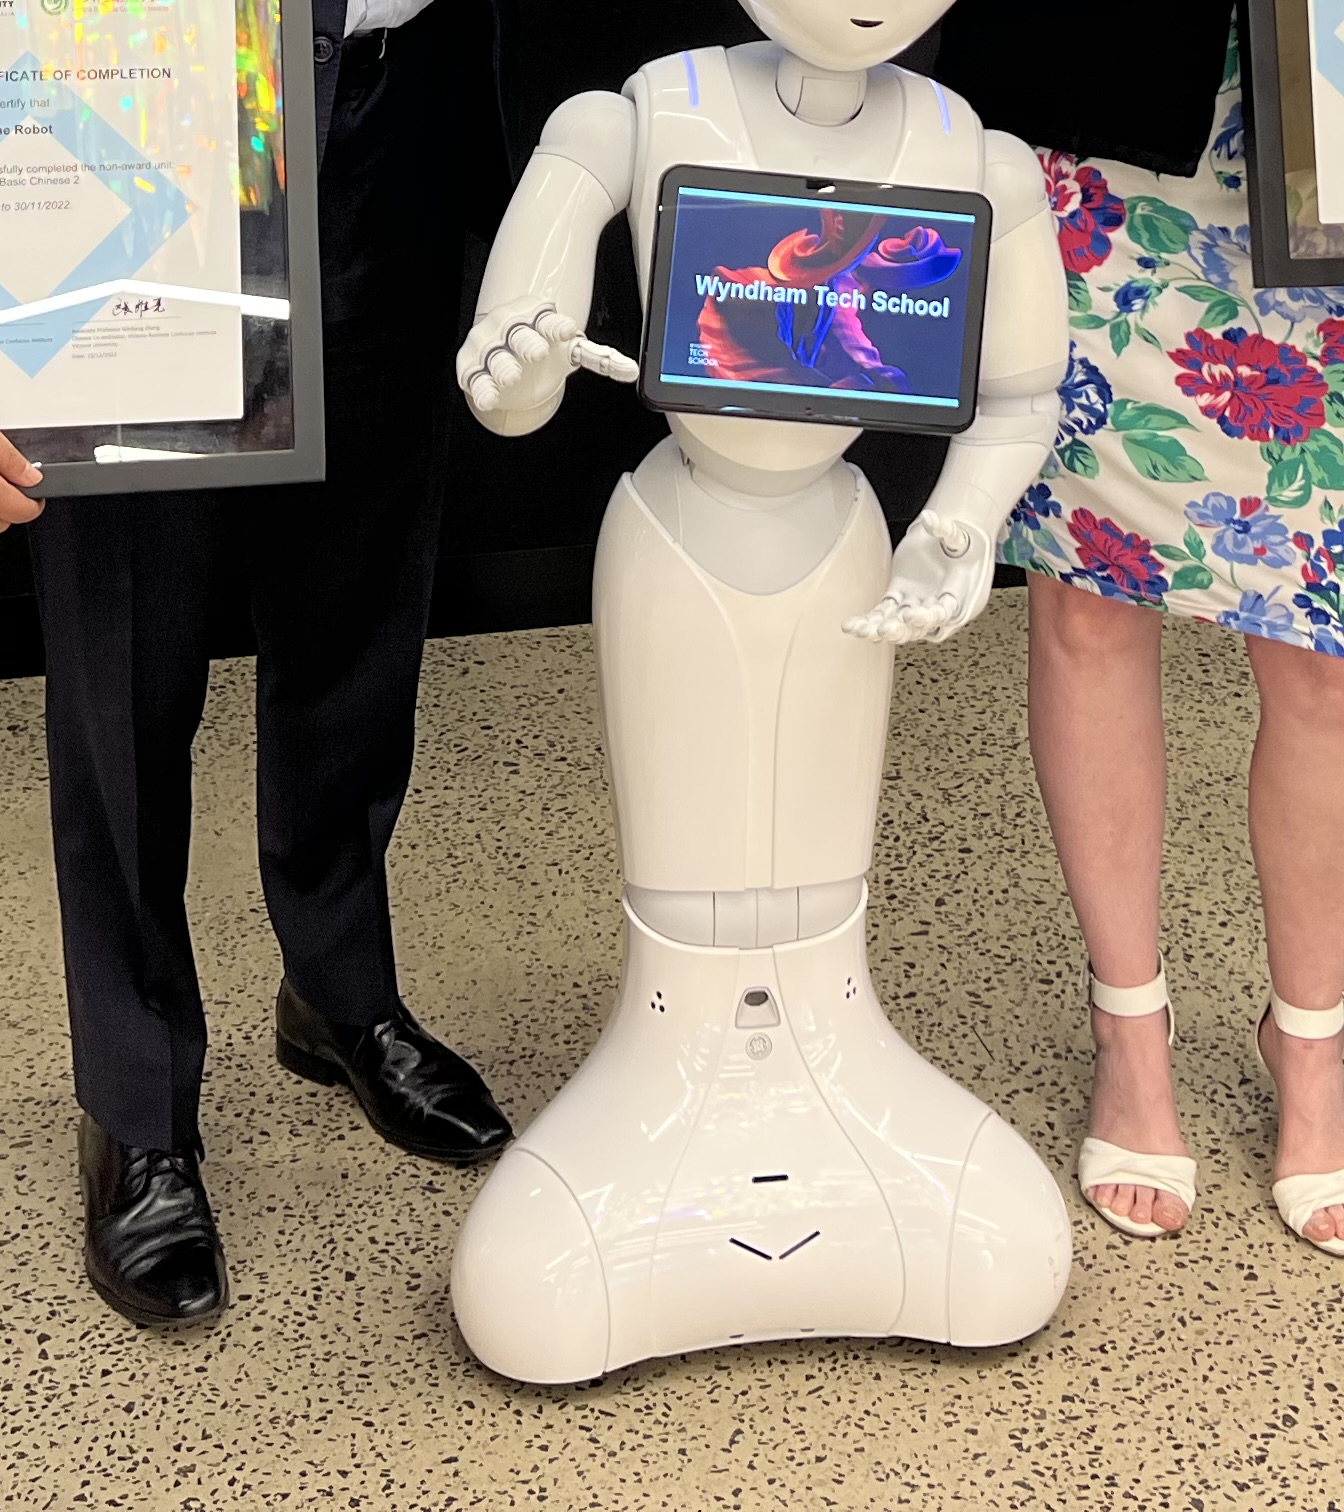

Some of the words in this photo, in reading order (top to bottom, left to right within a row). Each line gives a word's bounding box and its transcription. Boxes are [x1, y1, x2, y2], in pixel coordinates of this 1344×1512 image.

[53, 69, 73, 82] OF
[76, 67, 172, 81] COMPLETION
[30, 98, 50, 109] that
[14, 124, 54, 136] Robot
[26, 162, 78, 175] completed
[81, 162, 96, 172] the
[99, 161, 152, 172] non-award
[0, 175, 27, 187] Basic
[30, 175, 71, 186] Chinese
[73, 175, 80, 185] 2
[1, 200, 11, 212] to
[13, 200, 72, 212] 30/11/2022
[695, 274, 807, 304] Wyndham
[813, 285, 866, 309] Tech
[871, 290, 950, 318] School
